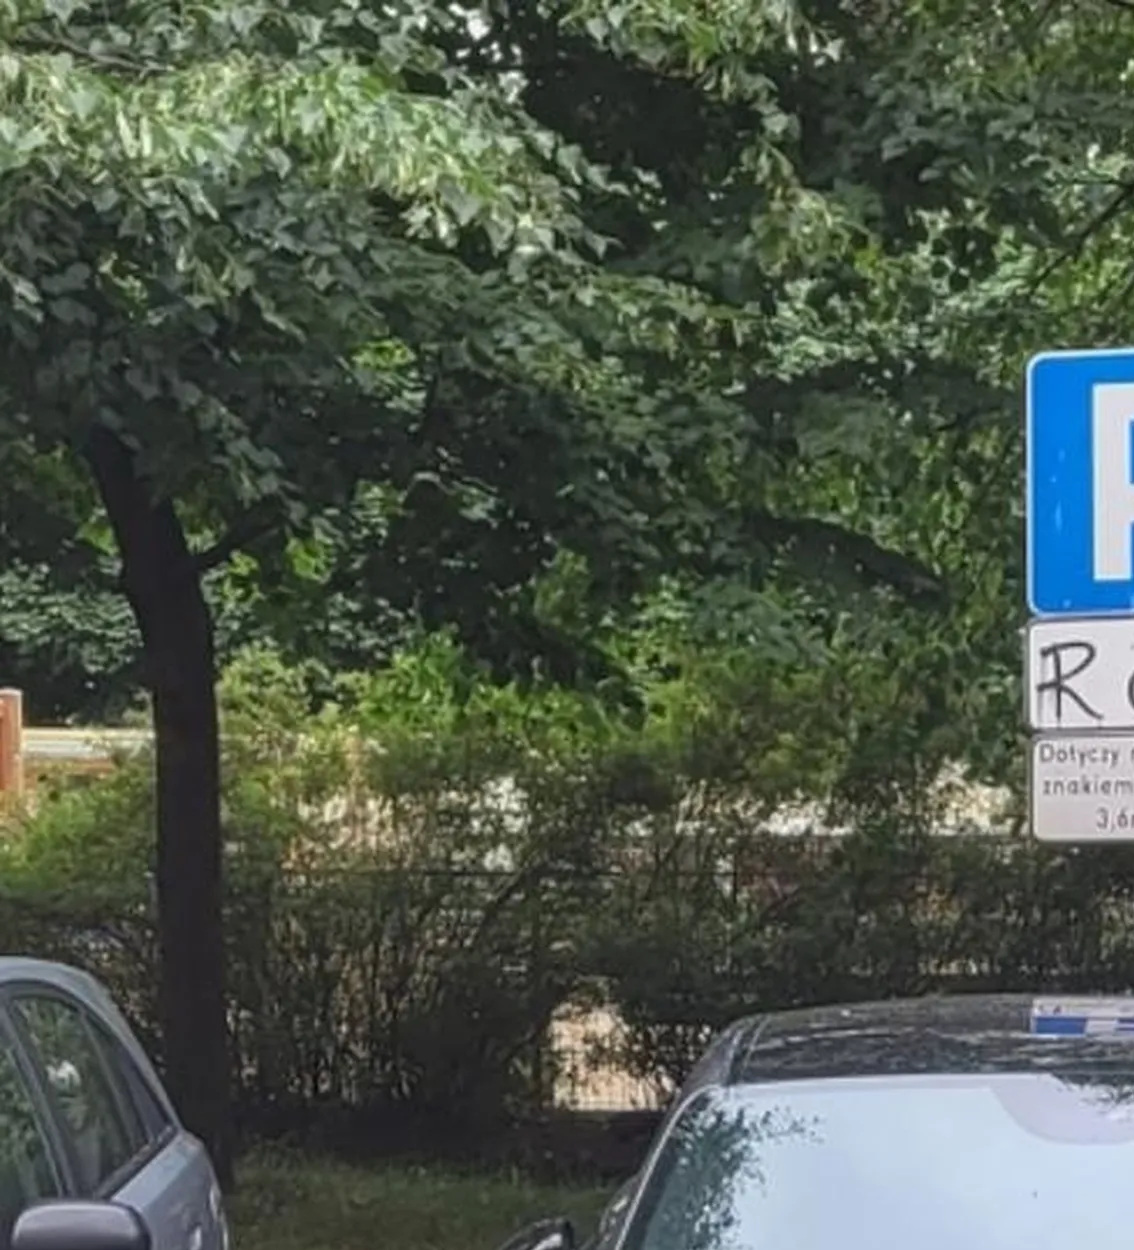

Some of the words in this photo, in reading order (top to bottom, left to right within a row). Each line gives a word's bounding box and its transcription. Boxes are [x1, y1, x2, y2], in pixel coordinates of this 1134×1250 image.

[1036, 641, 1104, 722] R
[1040, 743, 1119, 768] Dotyczy
[1042, 775, 1134, 796] znakiem
